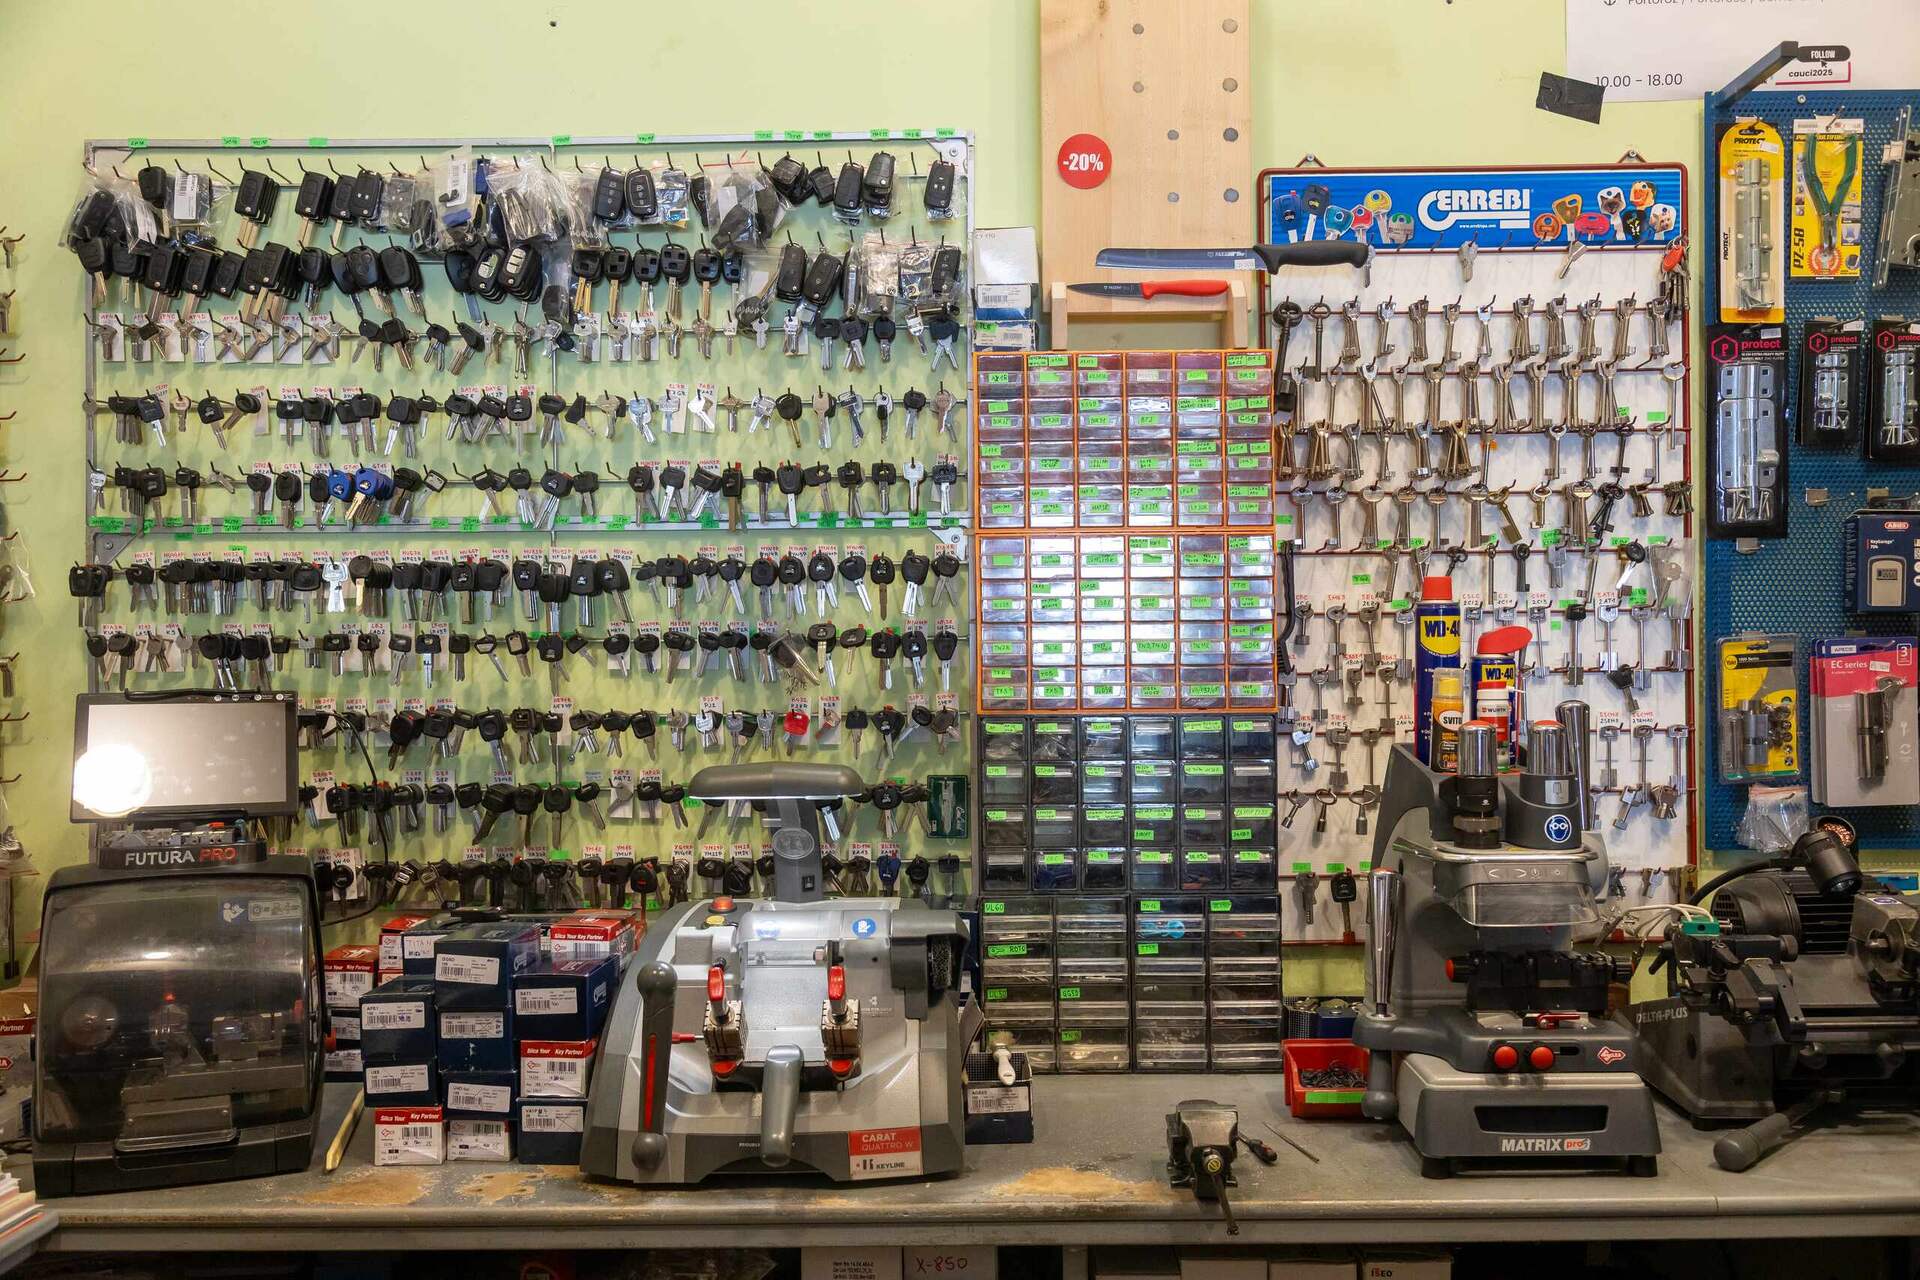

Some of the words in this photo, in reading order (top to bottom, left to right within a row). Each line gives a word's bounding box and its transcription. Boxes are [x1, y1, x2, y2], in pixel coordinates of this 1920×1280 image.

[1811, 50, 1836, 59] FOLLOW
[1788, 68, 1833, 78] cauci2025
[1647, 74, 1683, 87] 18.00
[1062, 152, 1104, 171] -20%
[1830, 335, 1857, 343] protect
[1742, 339, 1781, 352] protect
[1900, 646, 1908, 657] 3
[1831, 660, 1843, 668] EC
[125, 850, 195, 866] FUTURA
[199, 847, 237, 864] PRO
[1636, 1007, 1688, 1023] DELTA-PLUS
[862, 1132, 896, 1142] CARAT
[862, 1143, 903, 1151] QUATTRO
[1501, 1138, 1562, 1152] MATRIX
[915, 1256, 968, 1274] X-850
[1371, 1267, 1393, 1278] ISEO
